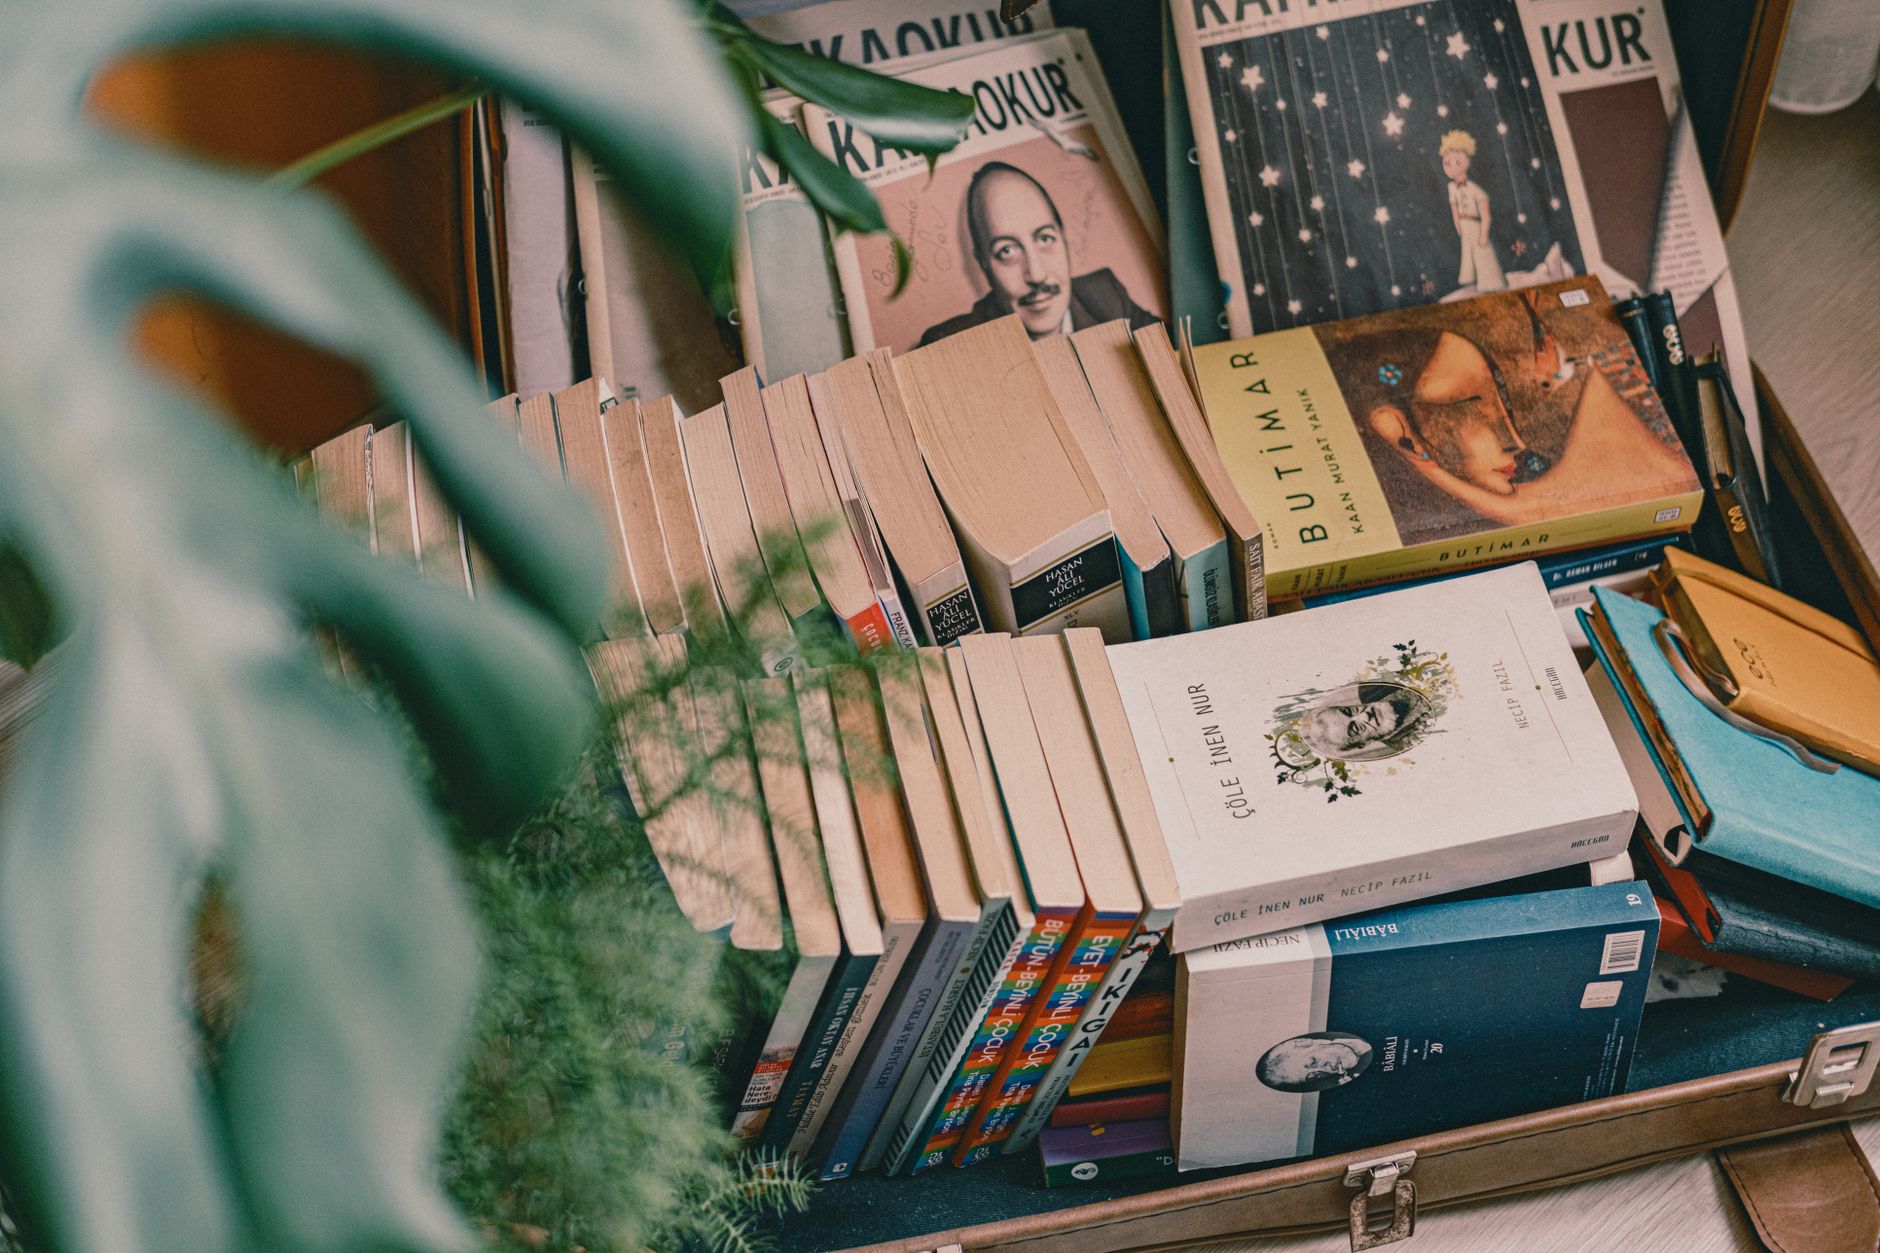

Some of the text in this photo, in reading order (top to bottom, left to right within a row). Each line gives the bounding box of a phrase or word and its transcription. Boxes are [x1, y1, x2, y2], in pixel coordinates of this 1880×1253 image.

[1229, 352, 1329, 544] BUTİMAR
[1296, 388, 1364, 534] KAAN MURAT YANIK
[1439, 533, 1549, 562] BUTİMAR
[1045, 557, 1083, 583] HASAN
[929, 591, 968, 617] HASAN
[891, 611, 908, 639] FRANZ
[1492, 659, 1513, 692] FAZIL
[1187, 683, 1256, 819] ÇÖLE İNEN NUR
[1214, 871, 1433, 926] ÇÖLE İNEN NUR NECİP FAZIL
[1255, 934, 1301, 949] NECİP
[1067, 967, 1132, 1067] IKIGAI
[978, 1018, 1013, 1063] ÇOCUK
[1022, 1023, 1062, 1070] ÇOCUK
[1430, 1043, 1444, 1054] 20
[964, 1071, 980, 1087] Tina
